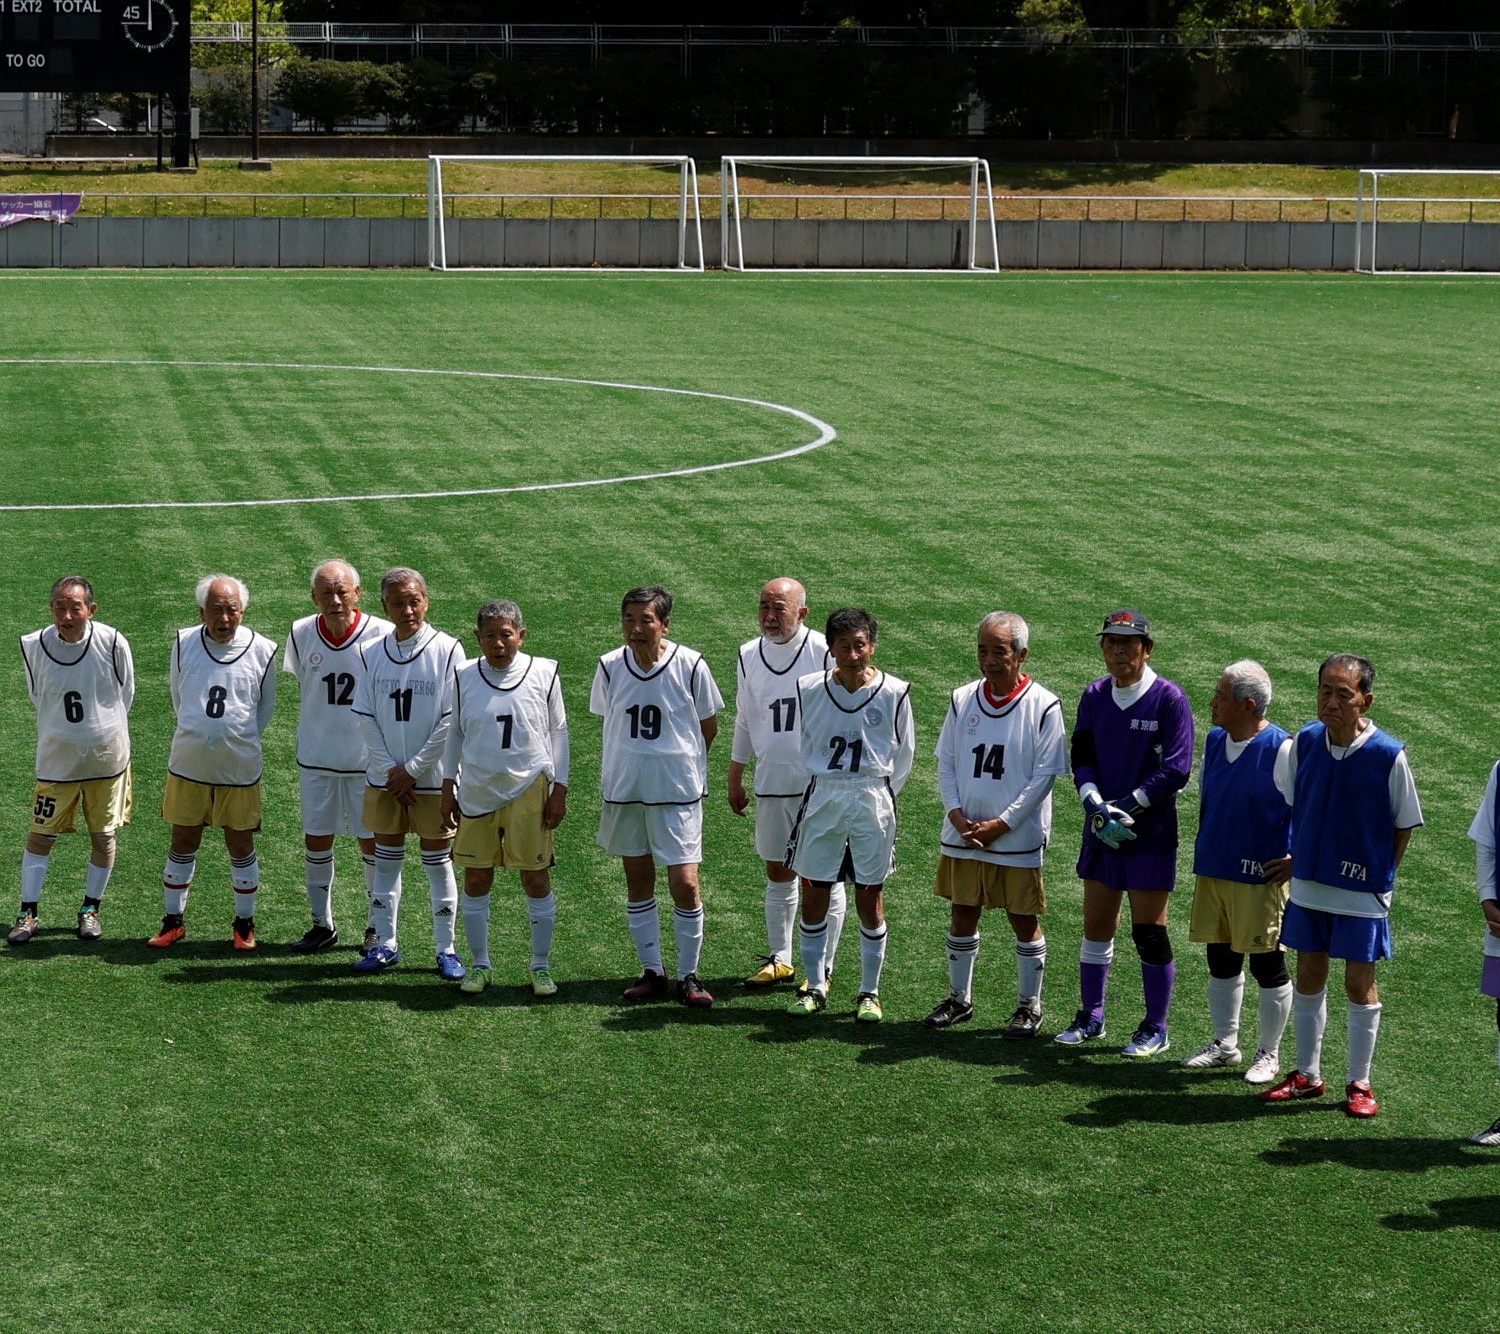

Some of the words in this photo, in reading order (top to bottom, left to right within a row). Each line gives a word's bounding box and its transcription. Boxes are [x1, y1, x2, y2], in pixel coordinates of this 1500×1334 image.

[12, 0, 42, 13] EXT2
[53, 0, 102, 13] TOTAL
[123, 6, 140, 20] 45
[6, 54, 23, 68] TO
[27, 54, 45, 68] GO
[205, 685, 227, 719] 8
[321, 672, 355, 706] 12
[389, 688, 413, 722] 11
[63, 690, 84, 724] 6
[626, 704, 662, 740] 19
[768, 697, 796, 733] 17
[496, 714, 513, 749] 7
[1129, 718, 1158, 731] 東京都
[827, 735, 863, 773] 21
[971, 743, 1005, 780] 14
[34, 795, 57, 819] 55
[1340, 859, 1367, 882] TFA
